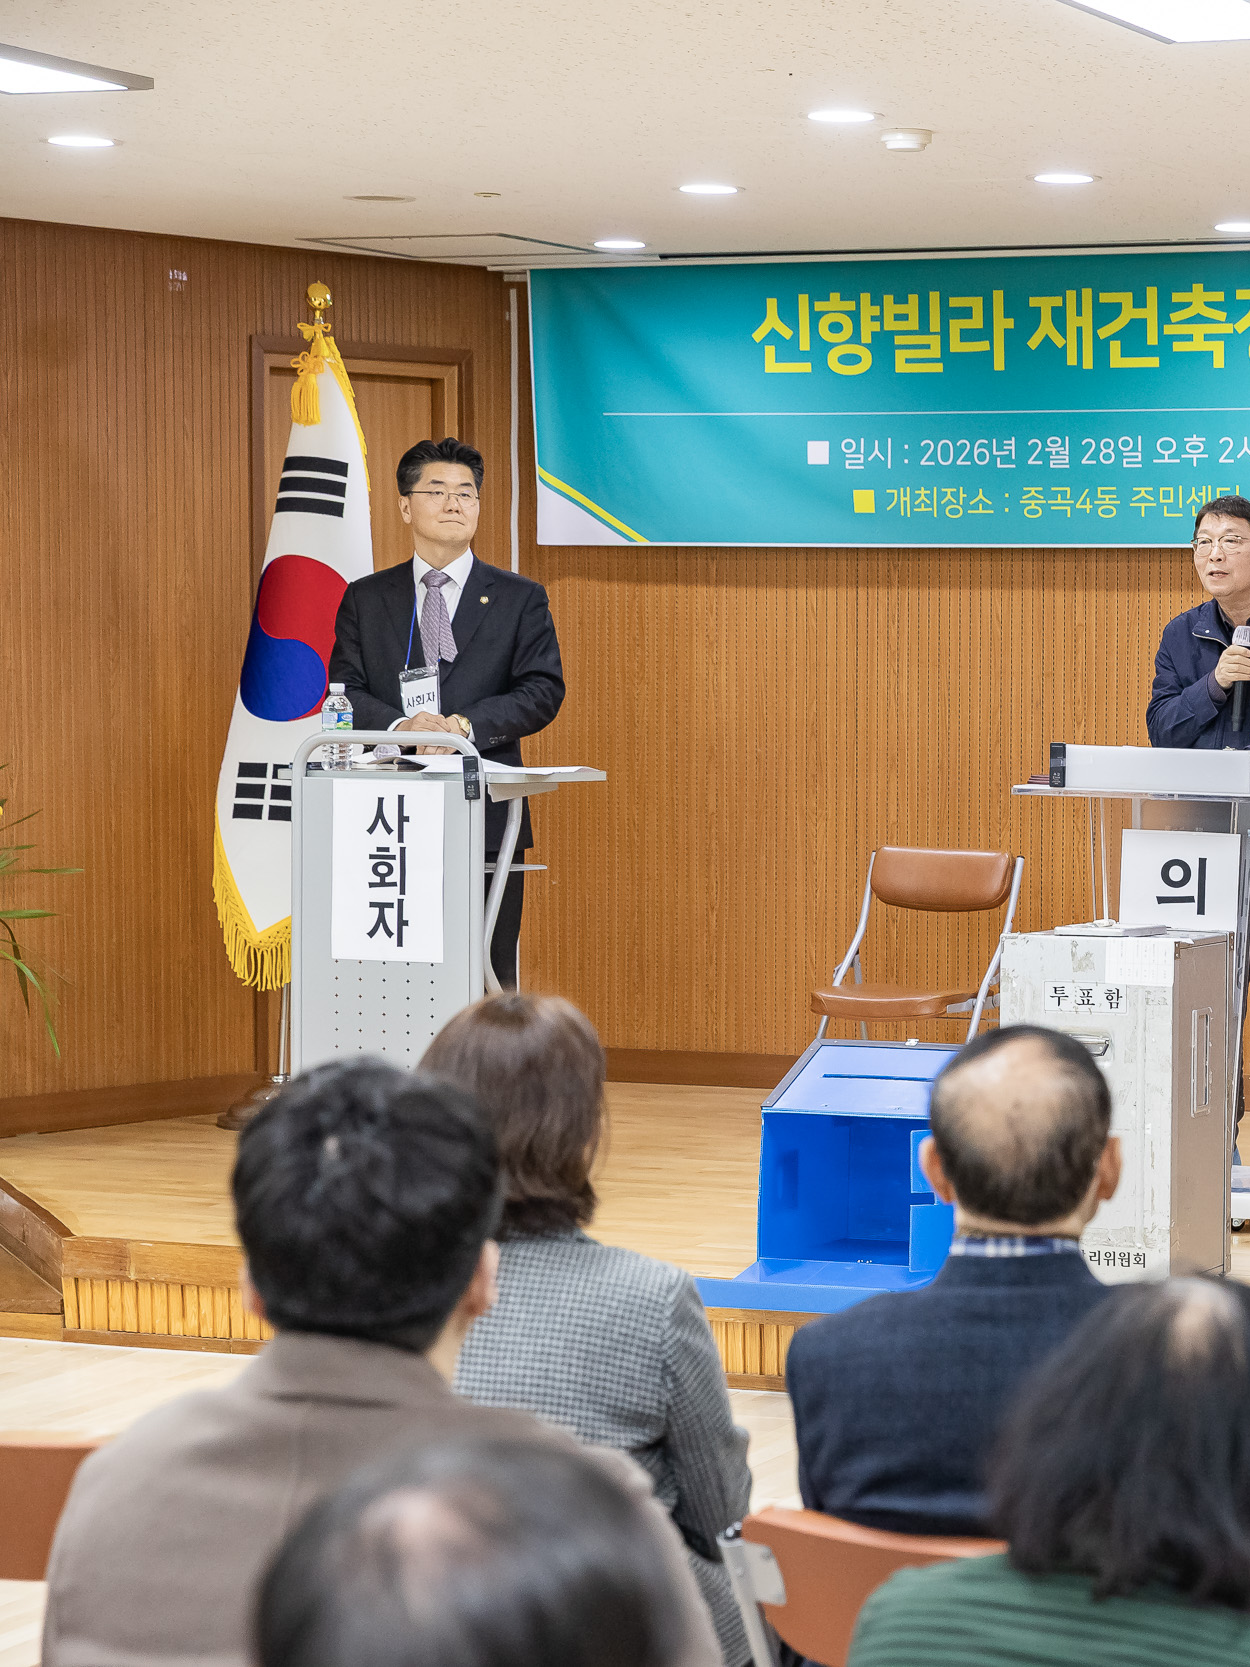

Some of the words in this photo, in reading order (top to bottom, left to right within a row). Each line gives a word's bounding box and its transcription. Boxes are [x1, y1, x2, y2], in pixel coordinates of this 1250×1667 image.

[750, 290, 1015, 375] 신향빌라
[841, 437, 892, 470] 일시
[919, 436, 1017, 468] 2026년
[1027, 436, 1070, 469] 2월
[1081, 435, 1143, 468] 28일
[1152, 433, 1209, 467] 오후
[886, 486, 995, 519] 개최장소
[1019, 486, 1121, 519] 중곡4동
[406, 691, 436, 709] 사회자
[366, 793, 410, 948] 사회자
[1155, 857, 1208, 916] 의
[1082, 1249, 1147, 1269] 리위원회
